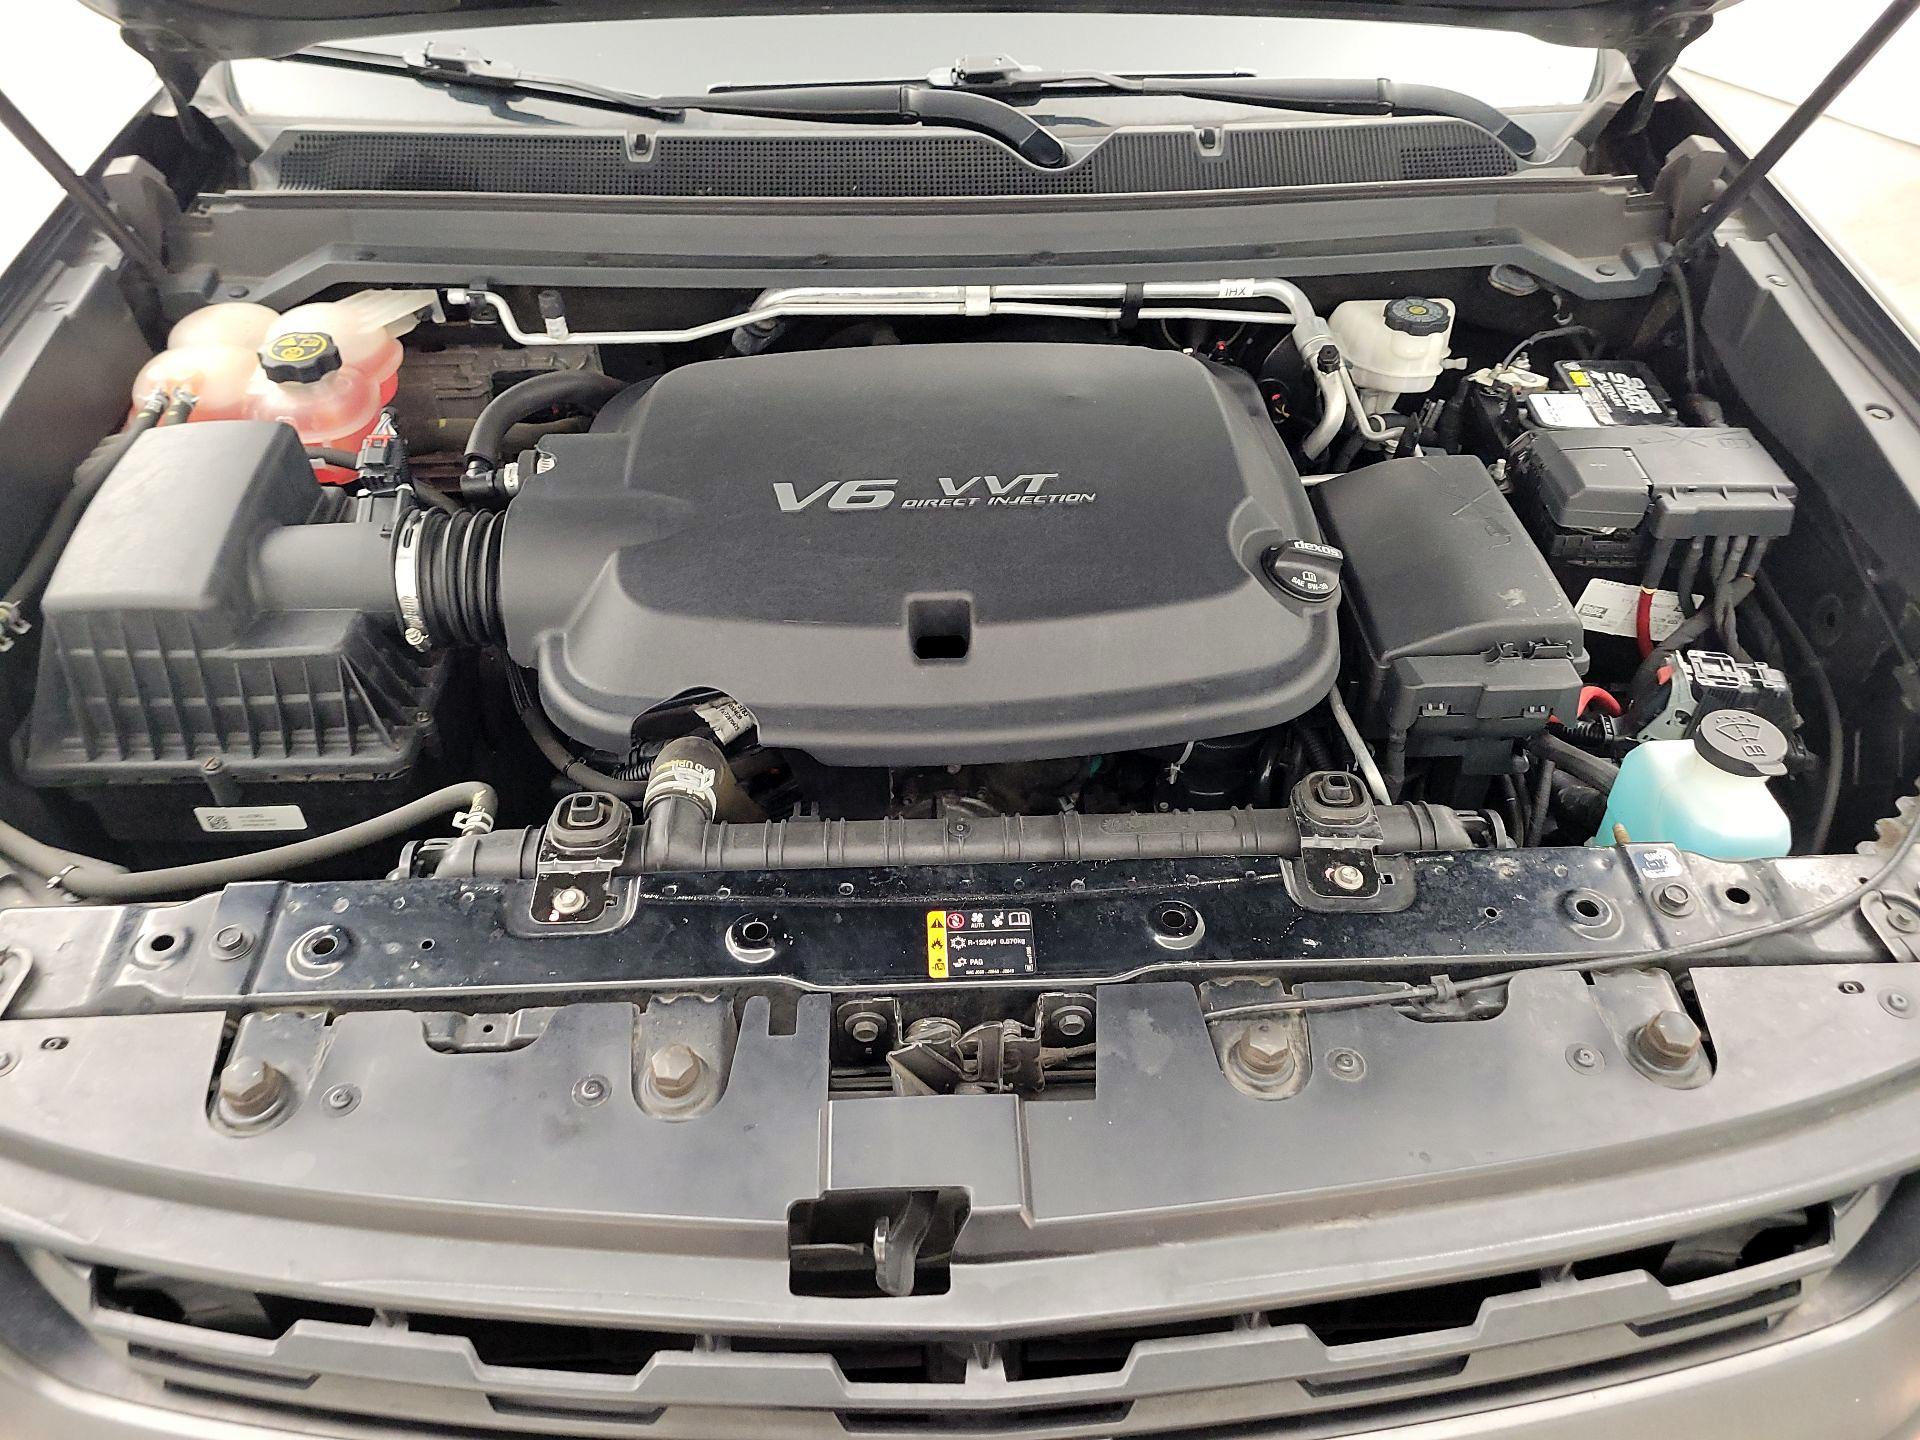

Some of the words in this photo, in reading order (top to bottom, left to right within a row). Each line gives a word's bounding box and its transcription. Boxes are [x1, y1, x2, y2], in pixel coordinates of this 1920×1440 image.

[938, 472, 1060, 496] VVT
[772, 478, 899, 511] V6
[901, 497, 981, 509] DIRECT
[987, 492, 1097, 506] INJECTION
[1294, 540, 1341, 558] dexos
[1290, 576, 1306, 588] SAE
[967, 938, 997, 947] R-1234yf
[969, 958, 984, 966] PAG
